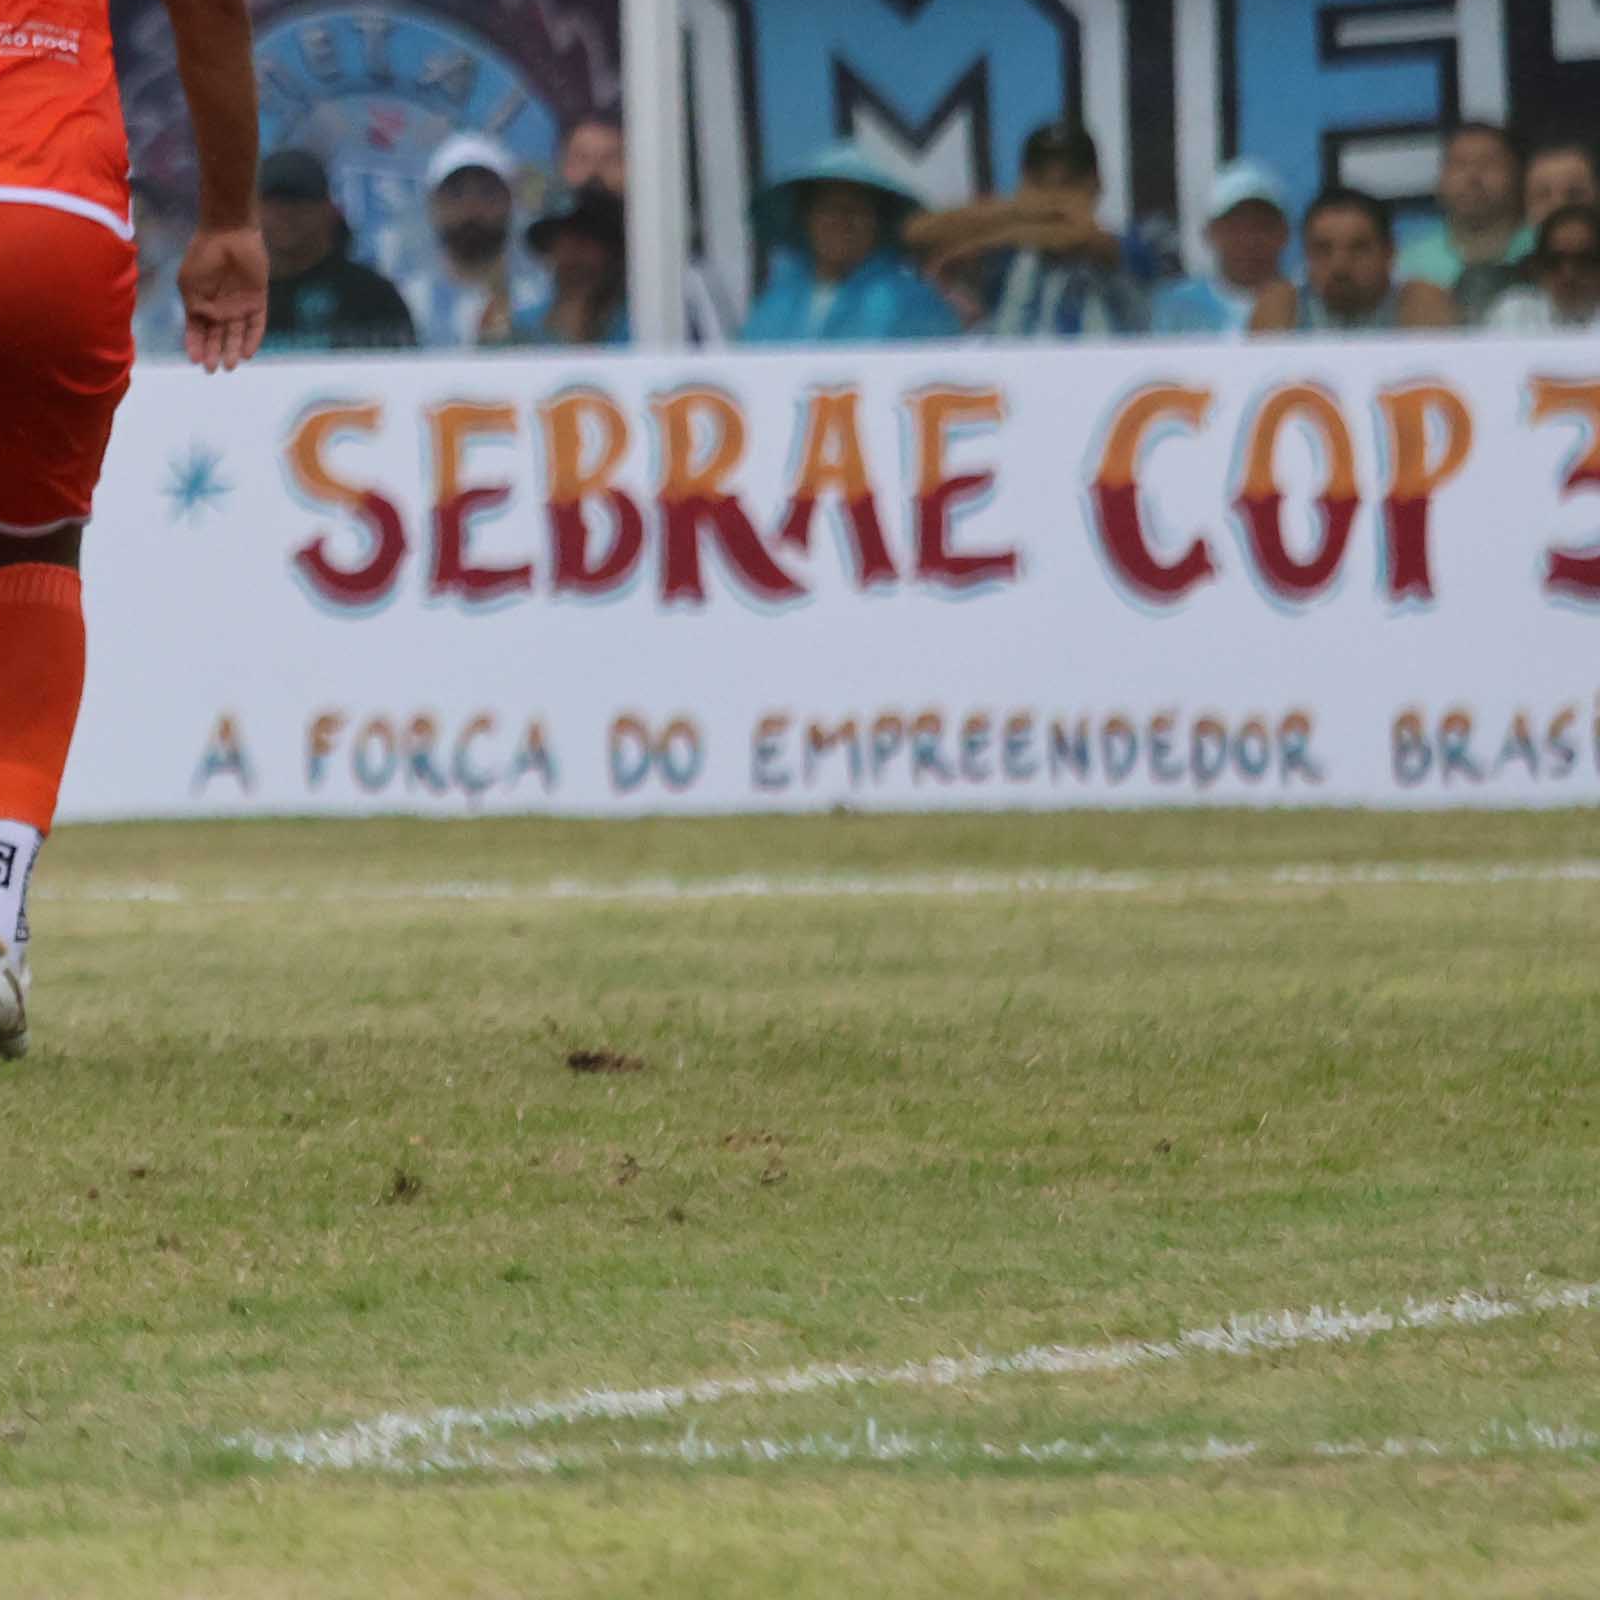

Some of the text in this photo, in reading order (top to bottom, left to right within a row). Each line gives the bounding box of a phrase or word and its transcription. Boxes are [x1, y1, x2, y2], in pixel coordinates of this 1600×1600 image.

[286, 388, 1020, 604] SEBRAE
[1090, 383, 1474, 604] COP
[203, 715, 252, 792] A
[308, 712, 557, 806] FORÇA
[609, 715, 709, 788] DO
[753, 711, 1325, 787] EMPREENDEDOR
